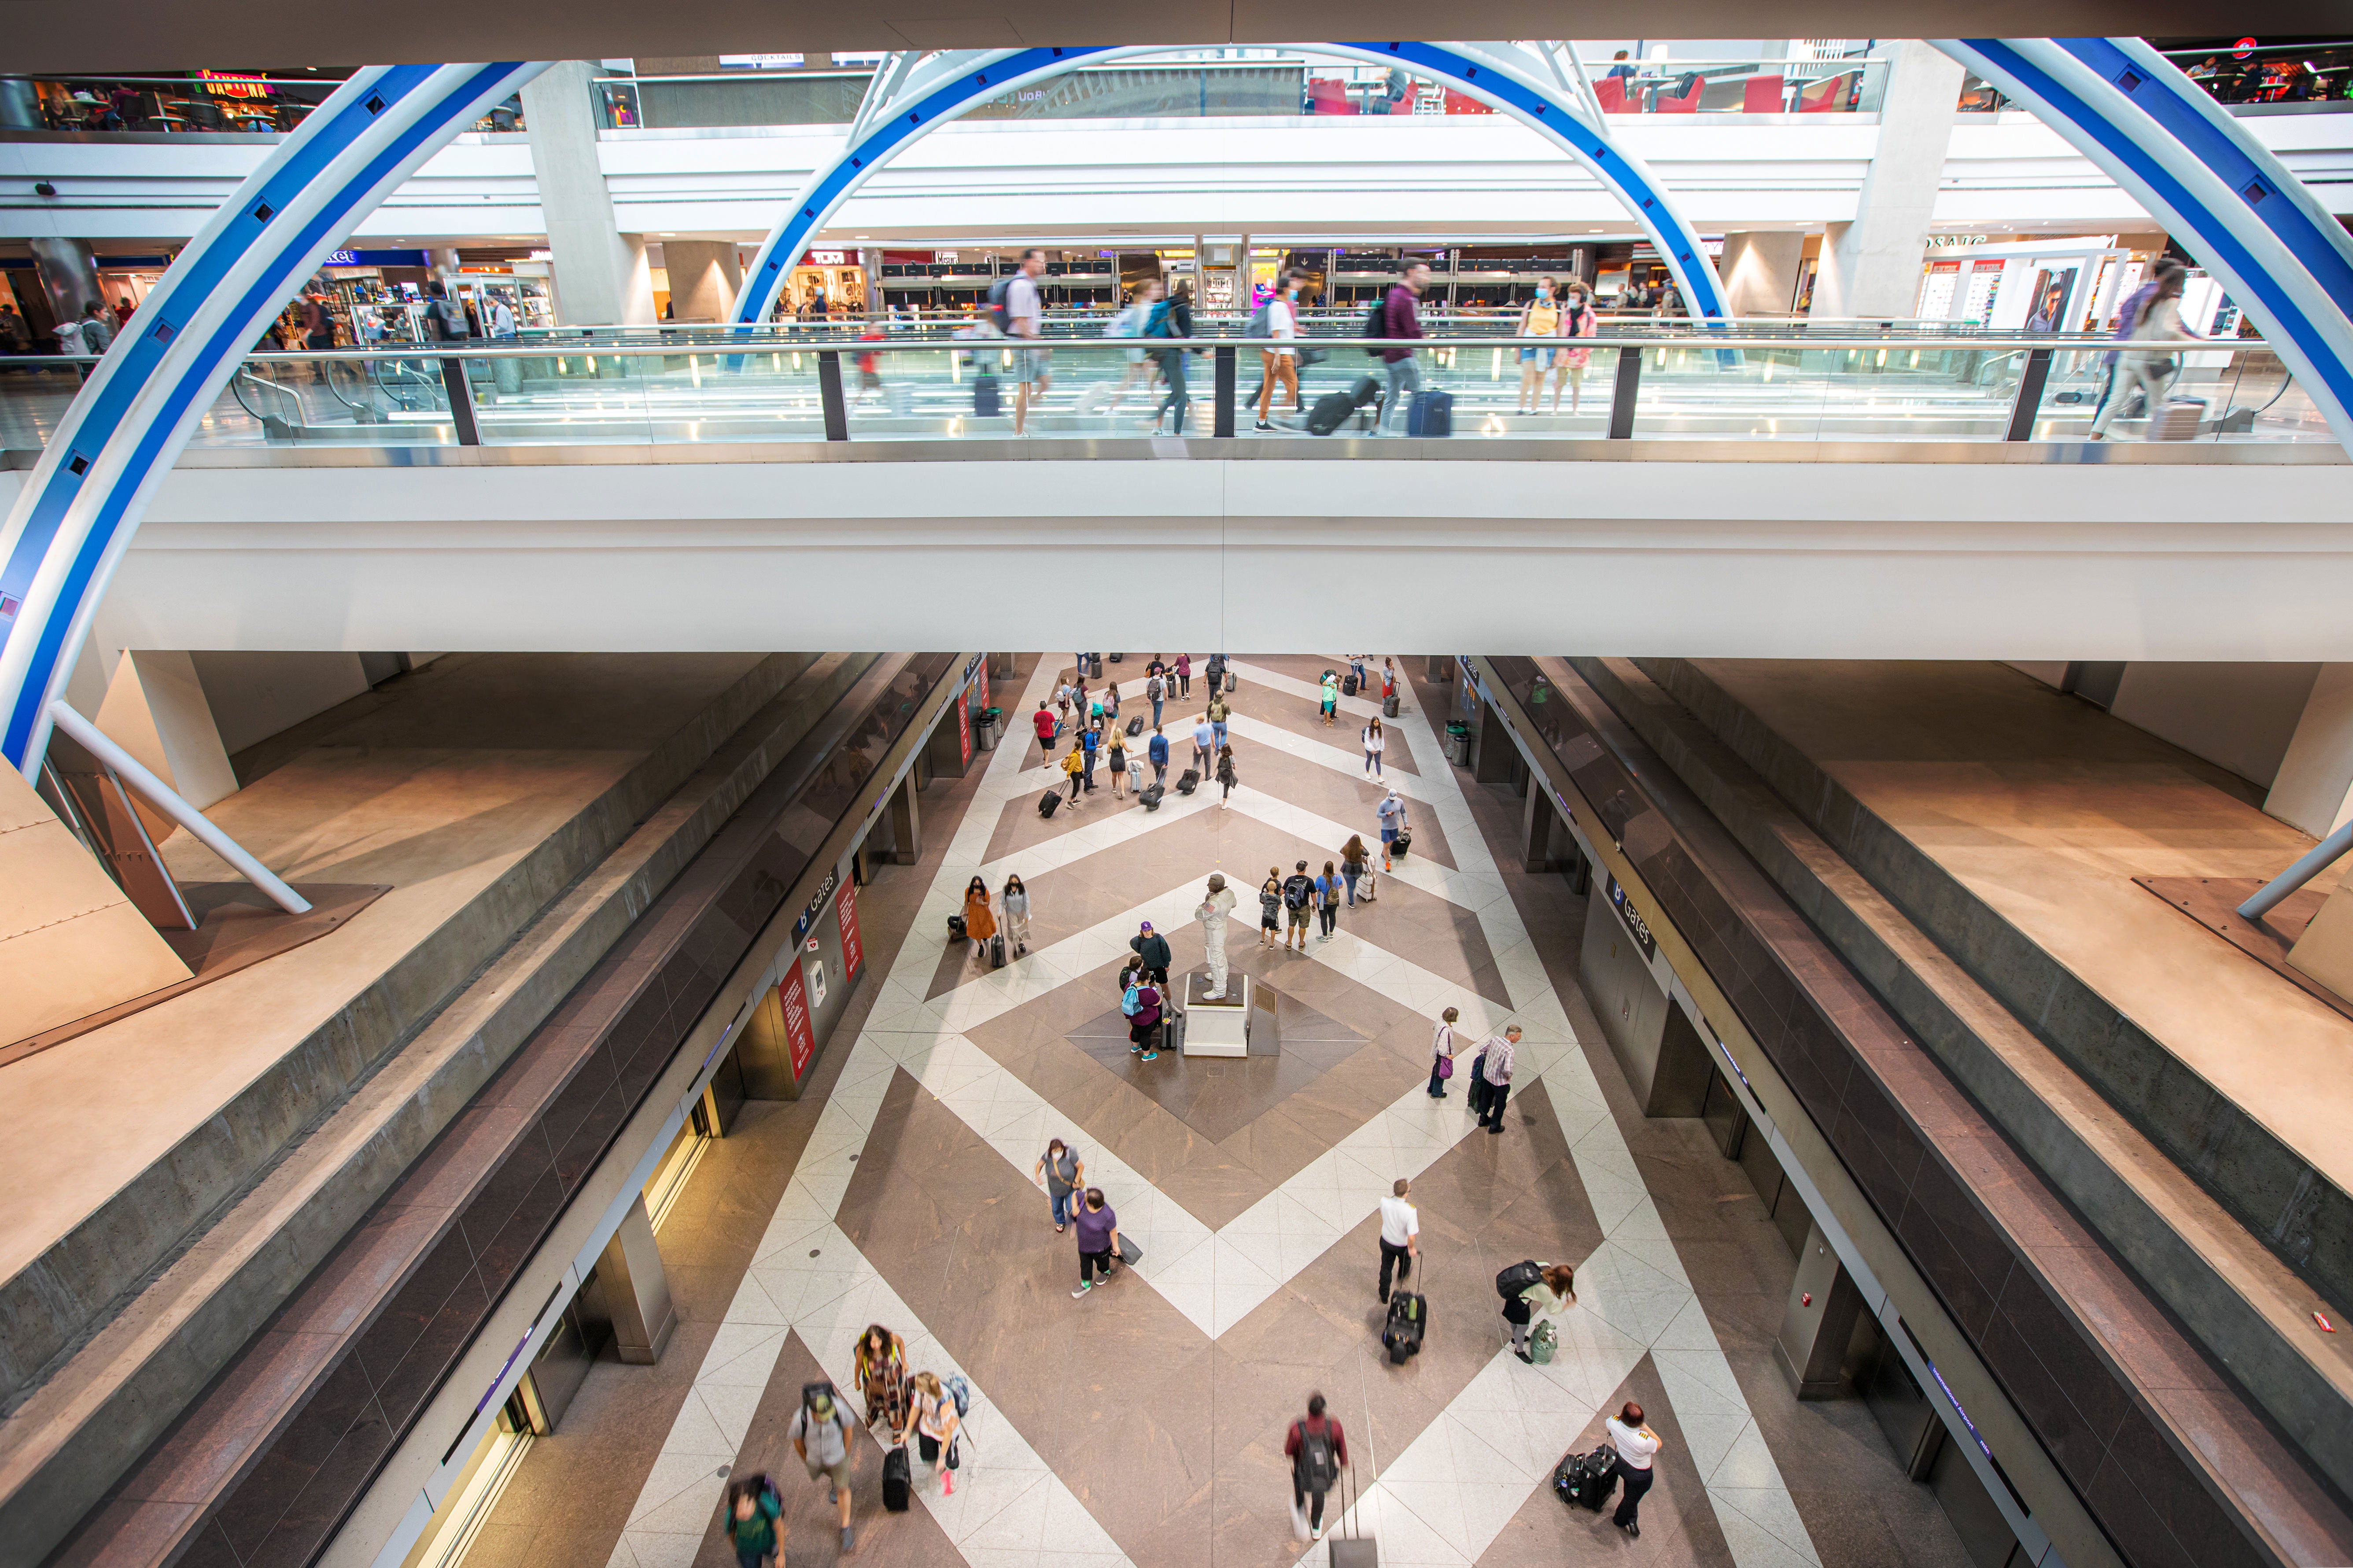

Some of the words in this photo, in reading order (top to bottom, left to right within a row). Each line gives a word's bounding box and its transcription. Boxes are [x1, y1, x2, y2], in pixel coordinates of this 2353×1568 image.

[811, 871, 833, 912] Gates
[1625, 898, 1649, 944] Gates
[784, 979, 797, 1001] Academic
[785, 984, 798, 1007] excellence
[793, 987, 801, 1002] tuition
[788, 1004, 799, 1025] radically
[1933, 1367, 1960, 1407] International
[1958, 1406, 1974, 1430] Airport
[1980, 1440, 1990, 1455] min
